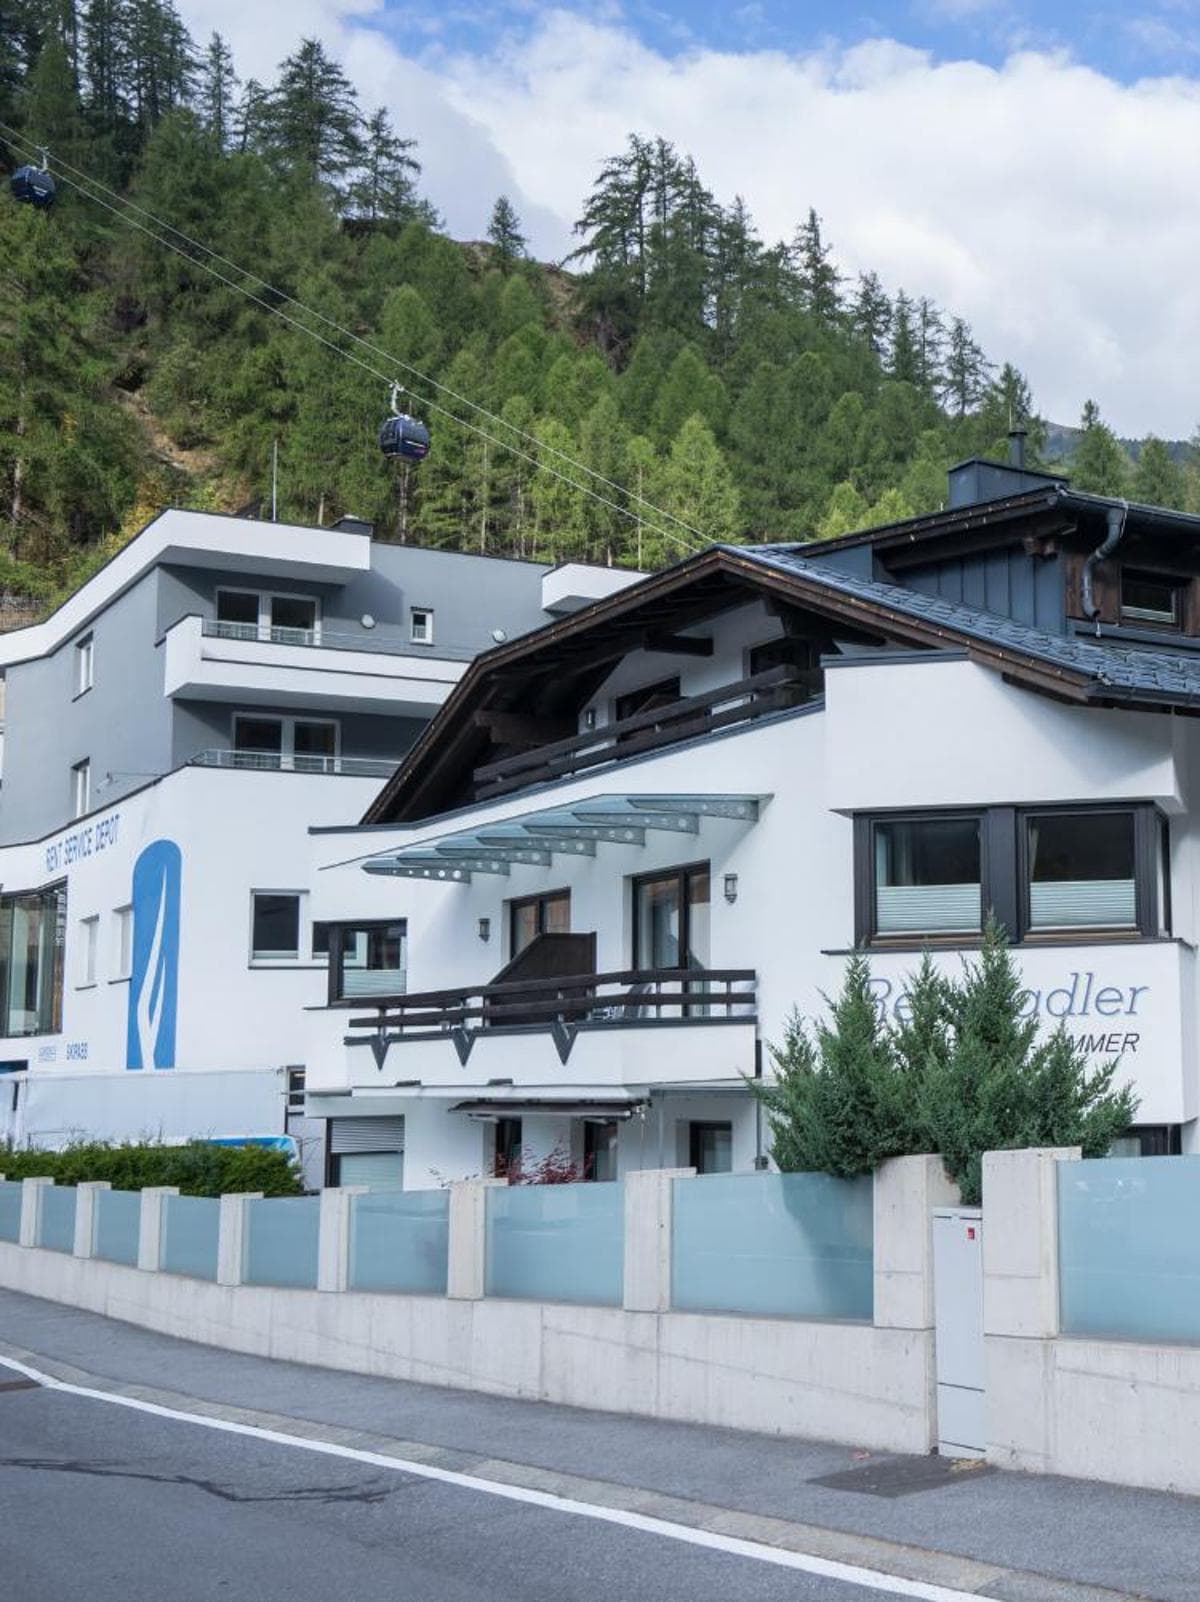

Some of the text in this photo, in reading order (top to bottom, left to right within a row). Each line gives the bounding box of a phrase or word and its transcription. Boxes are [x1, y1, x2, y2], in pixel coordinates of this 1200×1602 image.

[46, 813, 119, 872] RENT SERVICE DEPOT
